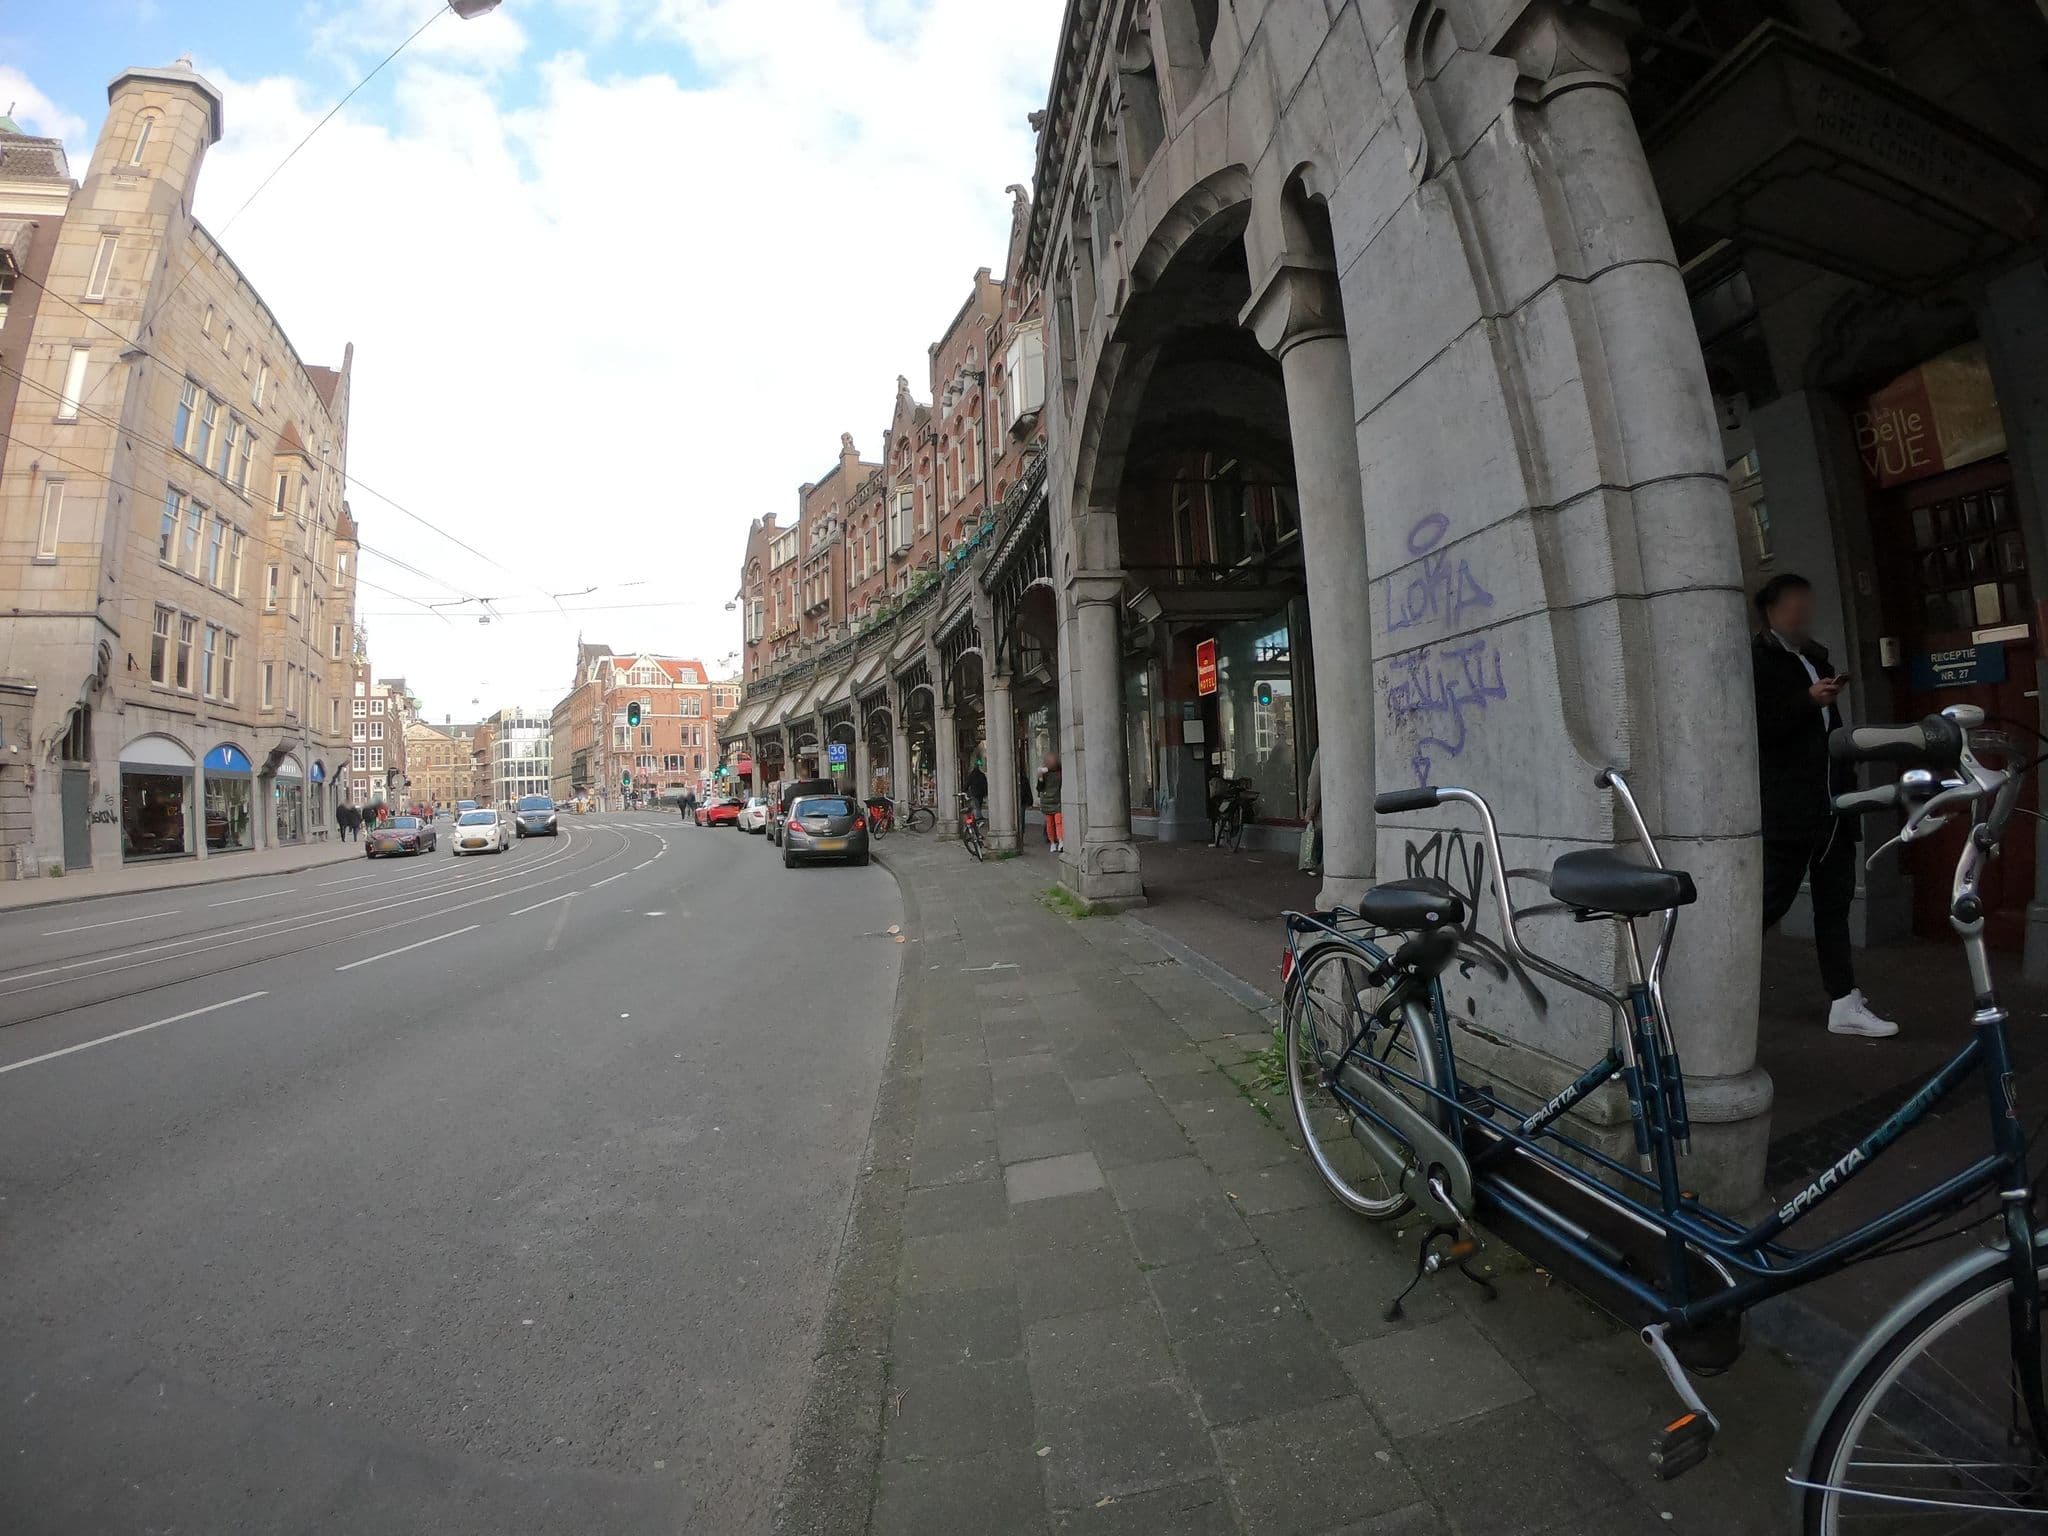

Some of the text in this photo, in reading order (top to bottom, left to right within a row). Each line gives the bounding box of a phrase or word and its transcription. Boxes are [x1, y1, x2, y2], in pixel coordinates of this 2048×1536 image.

[1852, 408, 1923, 451] Belle
[1861, 432, 1931, 480] VUE
[1930, 647, 1977, 663] RECEPTIE
[1958, 669, 1969, 679] 27
[830, 744, 845, 755] 30
[1522, 1084, 1579, 1132] SPARTA
[1778, 1147, 1866, 1226] SPARTA
